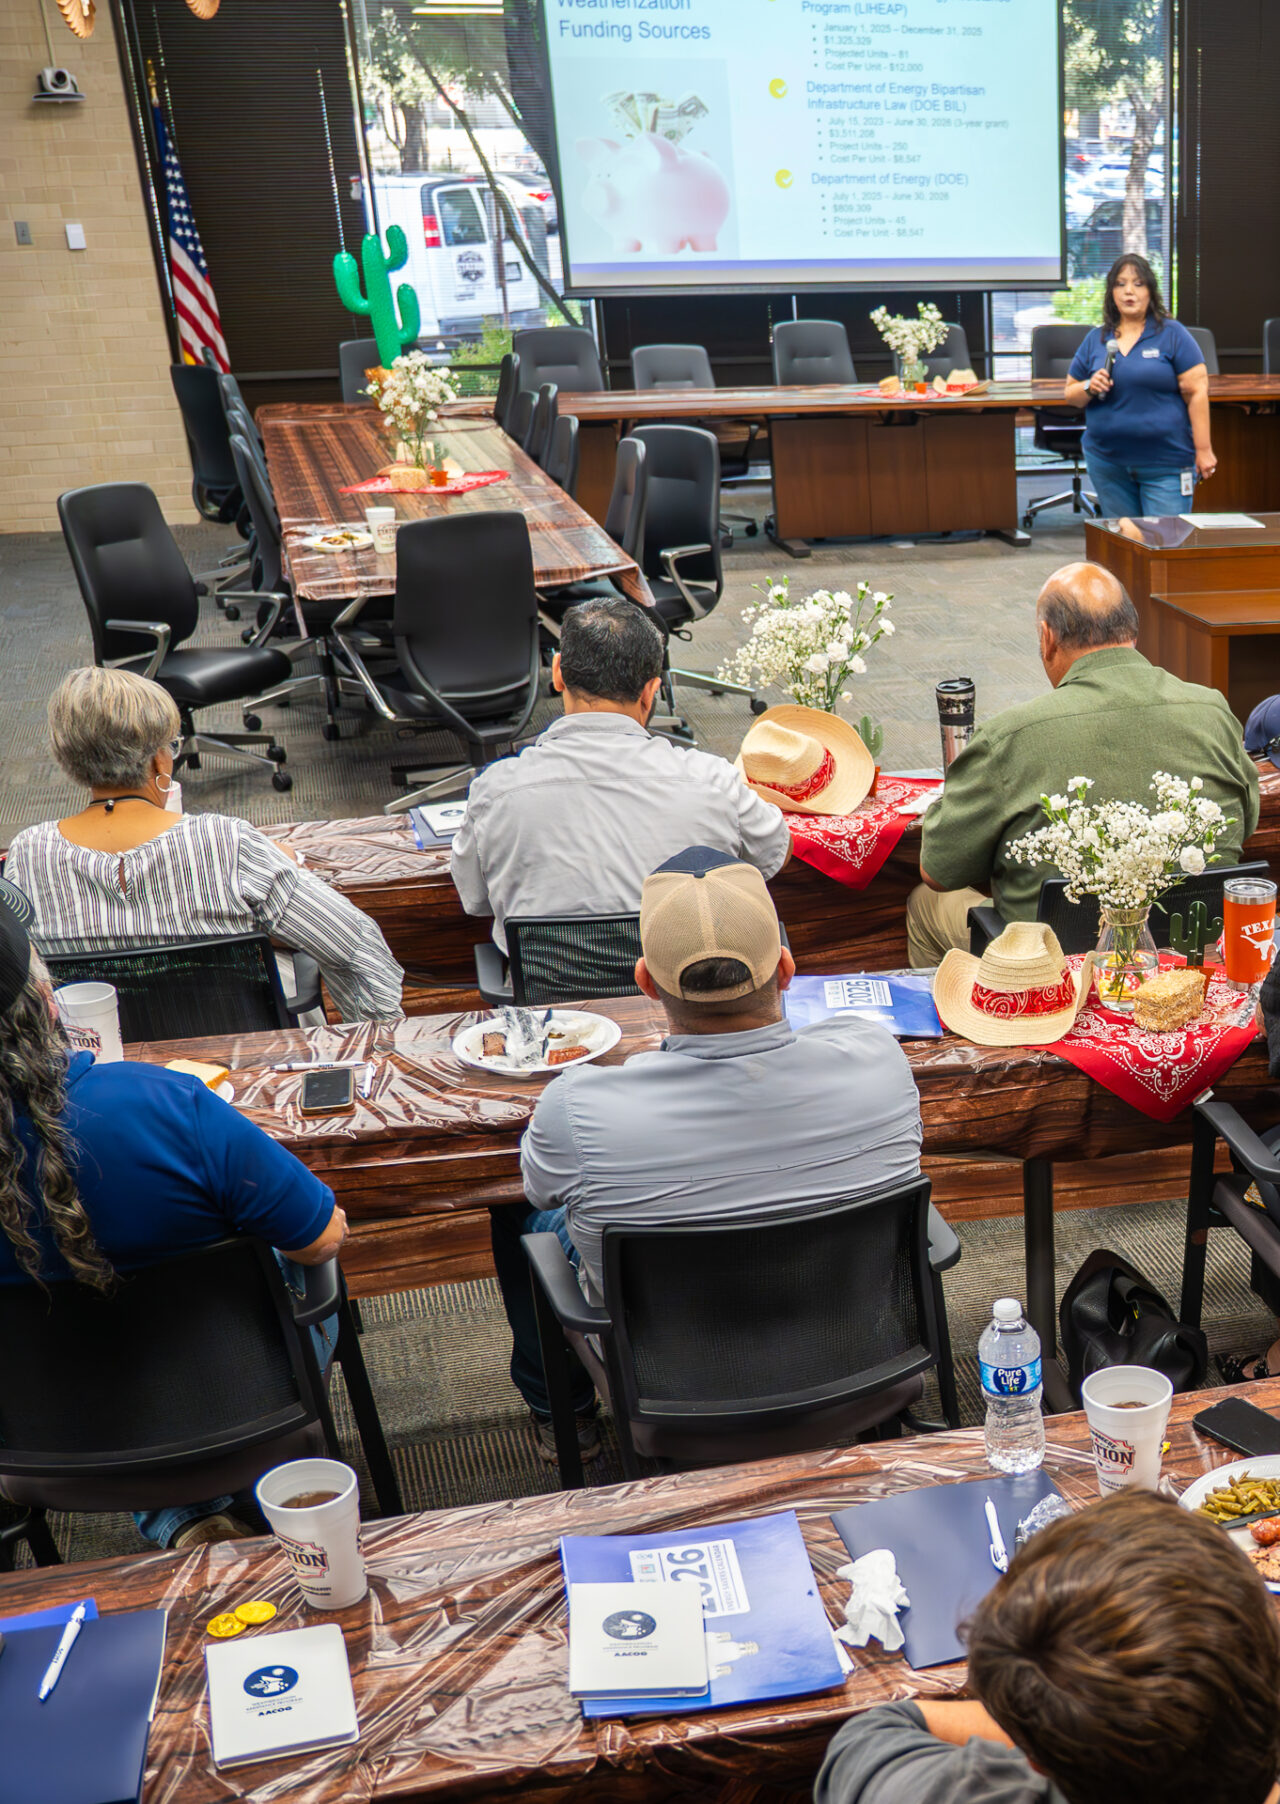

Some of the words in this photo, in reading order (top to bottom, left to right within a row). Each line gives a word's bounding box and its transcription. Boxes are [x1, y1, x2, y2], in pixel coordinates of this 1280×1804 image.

[801, 1, 850, 15] Program
[855, 1, 909, 17] (LIHEAP)
[559, 20, 632, 42] Funding
[638, 20, 711, 39] Sources
[824, 24, 857, 34] January
[901, 25, 944, 35] December
[825, 50, 865, 61] Projected
[867, 50, 889, 59] Units
[825, 61, 845, 71] Cost
[848, 62, 863, 71] Per
[865, 62, 882, 71] Unit
[806, 81, 872, 95] Department
[875, 81, 887, 92] of
[889, 82, 928, 97] Energy
[931, 83, 986, 98] Bipartisan
[808, 98, 881, 110] Infrastructure
[885, 99, 907, 110] Law
[910, 99, 940, 113] (DOE
[944, 100, 967, 114] BIL)
[828, 116, 845, 127] July
[894, 117, 914, 127] June
[829, 141, 859, 152] Project
[861, 141, 883, 151] Units
[830, 154, 850, 163] Cost
[852, 154, 867, 163] Per
[869, 154, 886, 163] Unit
[811, 172, 876, 186] Department
[879, 173, 890, 184] of
[893, 174, 931, 187] Energy
[934, 174, 969, 188] (DOE)
[832, 191, 850, 202] July
[892, 191, 912, 201] June
[833, 216, 863, 227] Project
[865, 216, 887, 225] Units
[833, 228, 854, 238] Cost
[856, 228, 870, 237] Per
[872, 228, 889, 237] Unit
[1241, 919, 1275, 936] TEX
[846, 981, 873, 1004] 2026
[997, 1368, 1022, 1377] Pure
[1001, 1376, 1020, 1387] Life
[1094, 1442, 1133, 1466] TION
[258, 1706, 293, 1717] AACOG
